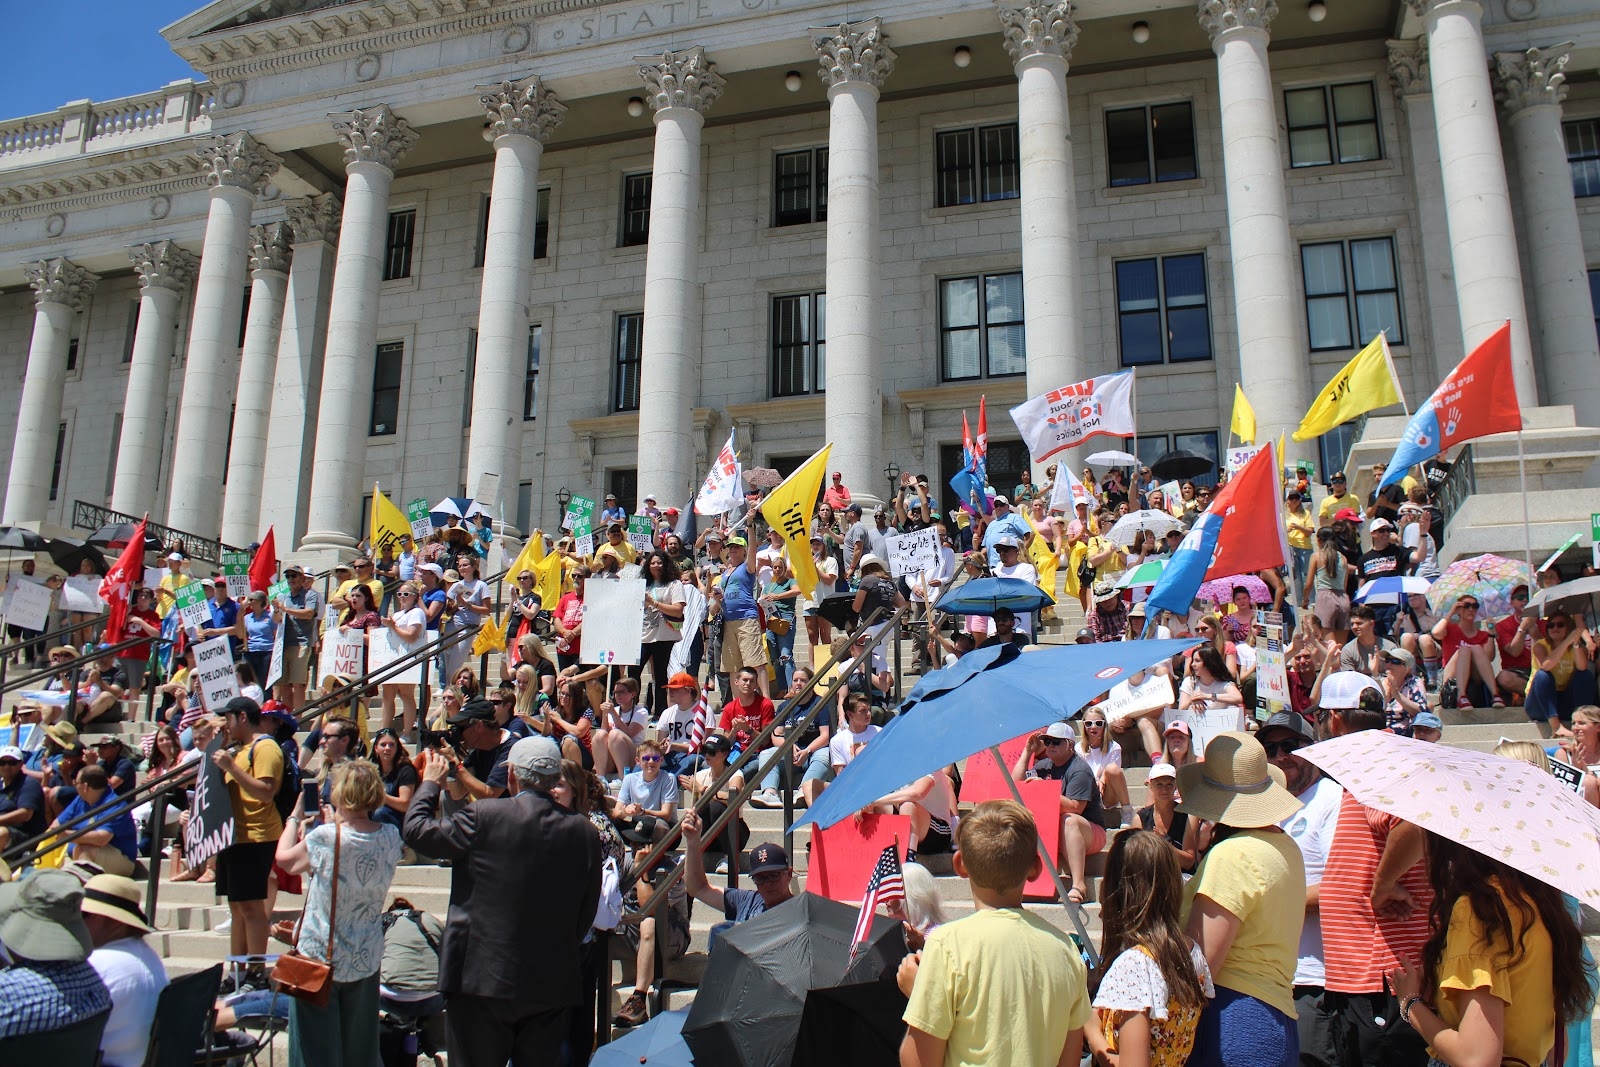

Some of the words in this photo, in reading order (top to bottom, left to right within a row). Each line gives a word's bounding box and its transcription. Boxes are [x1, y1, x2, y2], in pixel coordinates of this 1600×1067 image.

[579, 0, 714, 40] STATE
[571, 496, 584, 507] LOVE
[583, 499, 595, 510] LIFE
[413, 519, 430, 530] CHOOSE
[629, 516, 640, 526] LOVE
[641, 517, 651, 526] LIFE
[418, 529, 428, 538] LIFE
[630, 533, 649, 543] CHOOSE
[576, 535, 591, 547] CHOOSE
[634, 542, 645, 551] LIFE
[898, 536, 930, 557] Rights
[580, 545, 589, 556] LIFE
[225, 554, 237, 565] LOVE
[238, 554, 248, 564] LIFE
[228, 575, 249, 586] CHOOSE
[175, 586, 190, 600] LOVE
[190, 581, 203, 595] LIFE
[235, 586, 245, 596] LIFE
[268, 586, 280, 597] LOVE
[183, 602, 206, 617] CHOOSE
[191, 616, 204, 626] LIFE
[199, 644, 226, 662] ADOPTION
[336, 644, 362, 659] NOT
[200, 671, 212, 683] THE
[212, 665, 233, 679] LOVING
[335, 660, 358, 675] ME
[211, 688, 233, 702] OPTION
[1113, 697, 1131, 712] SHALL
[1133, 690, 1145, 700] ANY
[1147, 682, 1167, 697] STATE
[1187, 715, 1215, 728] ARE
[186, 816, 204, 852] PRO
[185, 816, 235, 871] WOMAN
